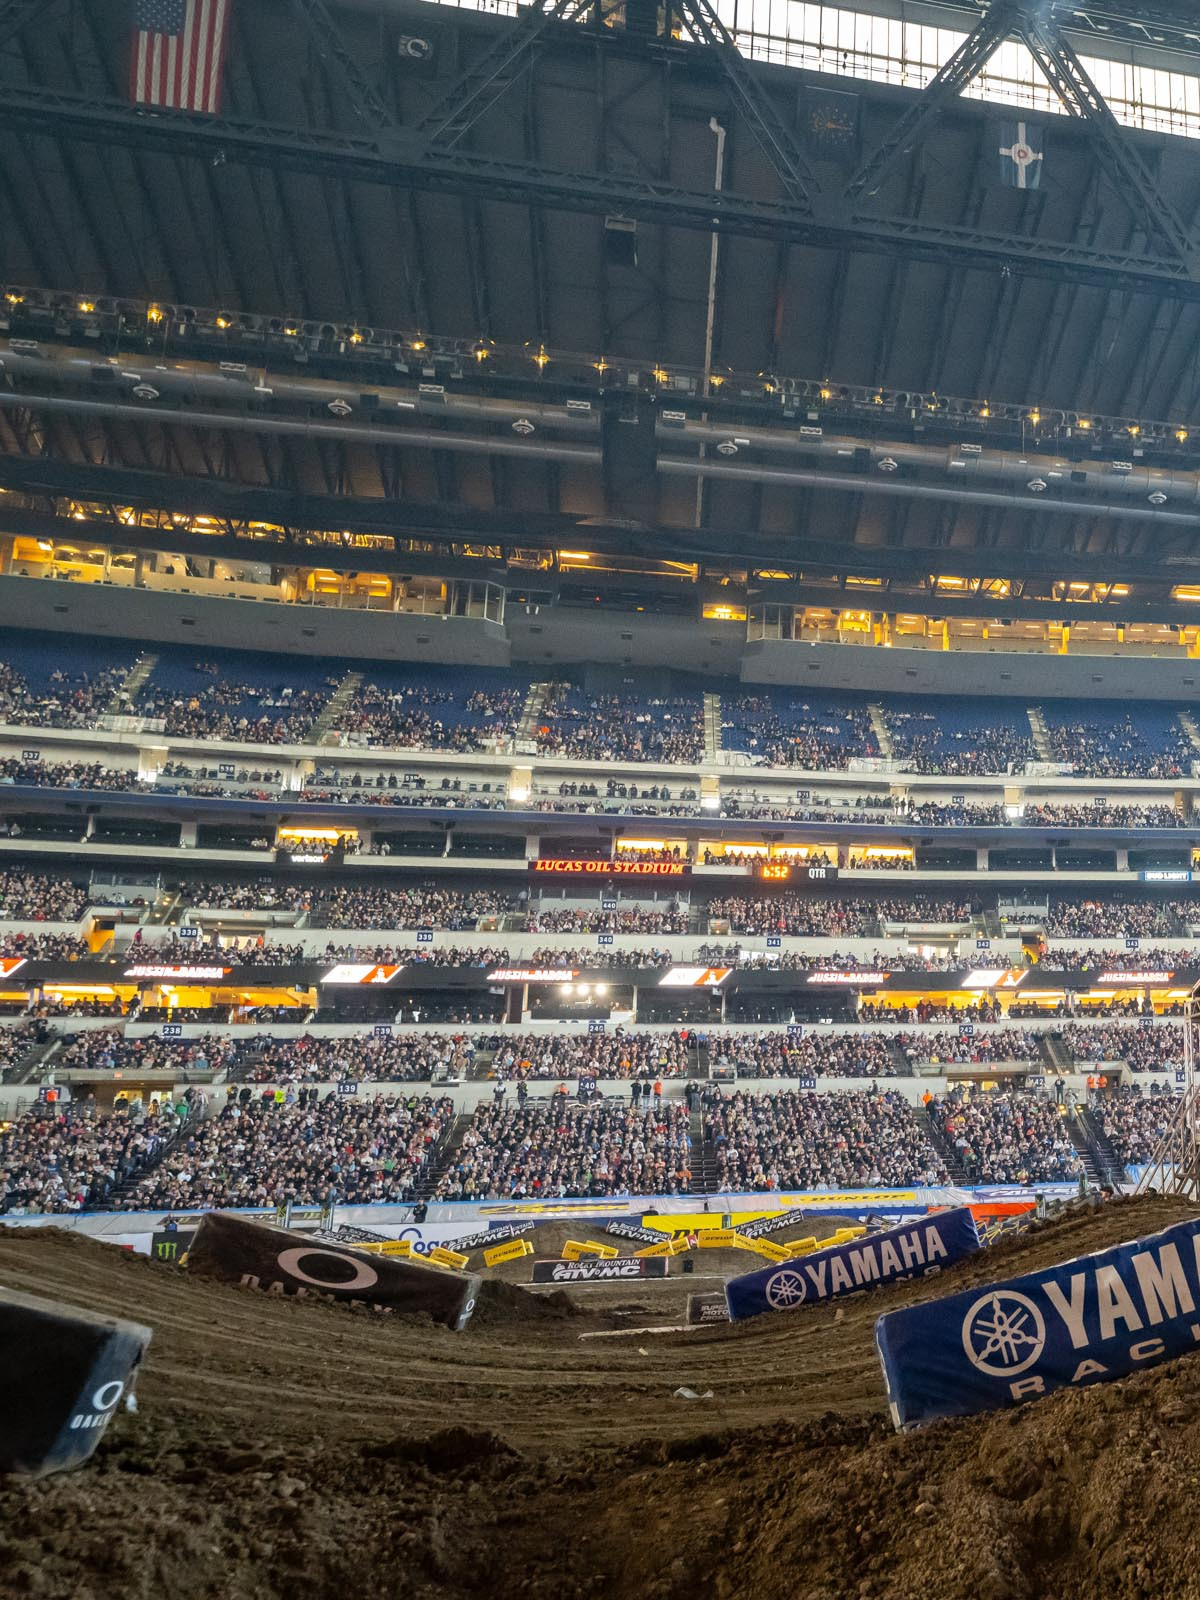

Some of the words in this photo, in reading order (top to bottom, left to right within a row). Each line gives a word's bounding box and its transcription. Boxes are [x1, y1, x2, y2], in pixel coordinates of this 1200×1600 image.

[536, 860, 583, 872] LUCAS
[586, 861, 611, 873] OIL
[614, 862, 685, 875] STADIUM
[808, 868, 826, 879] QTR
[164, 1026, 181, 1034] 238
[960, 1026, 973, 1034] 242
[339, 1085, 356, 1093] 139
[811, 1194, 906, 1202] DUNLOP
[772, 1211, 800, 1223] MOUNTAIN
[478, 1224, 509, 1237] MOUNTAIN
[620, 1222, 637, 1232] ROCKY
[638, 1227, 670, 1239] MOUNTAIN
[595, 1258, 641, 1268] MOUNTAIN
[805, 1225, 948, 1297] YAMAHA
